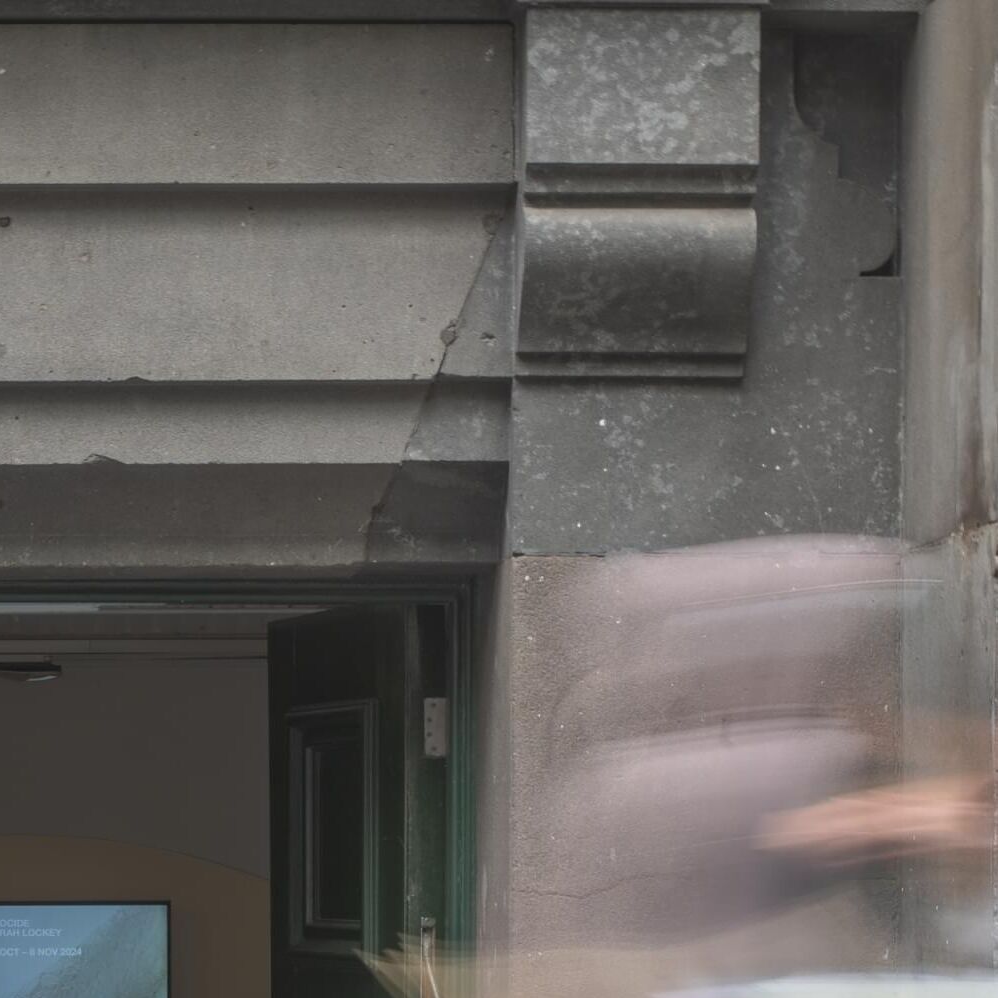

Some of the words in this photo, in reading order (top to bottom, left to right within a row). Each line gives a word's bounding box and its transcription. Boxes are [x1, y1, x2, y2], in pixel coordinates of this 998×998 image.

[22, 928, 61, 937] LOCKEY
[0, 947, 19, 957] OCT
[37, 947, 58, 957] NOV
[60, 947, 82, 957] 2024
